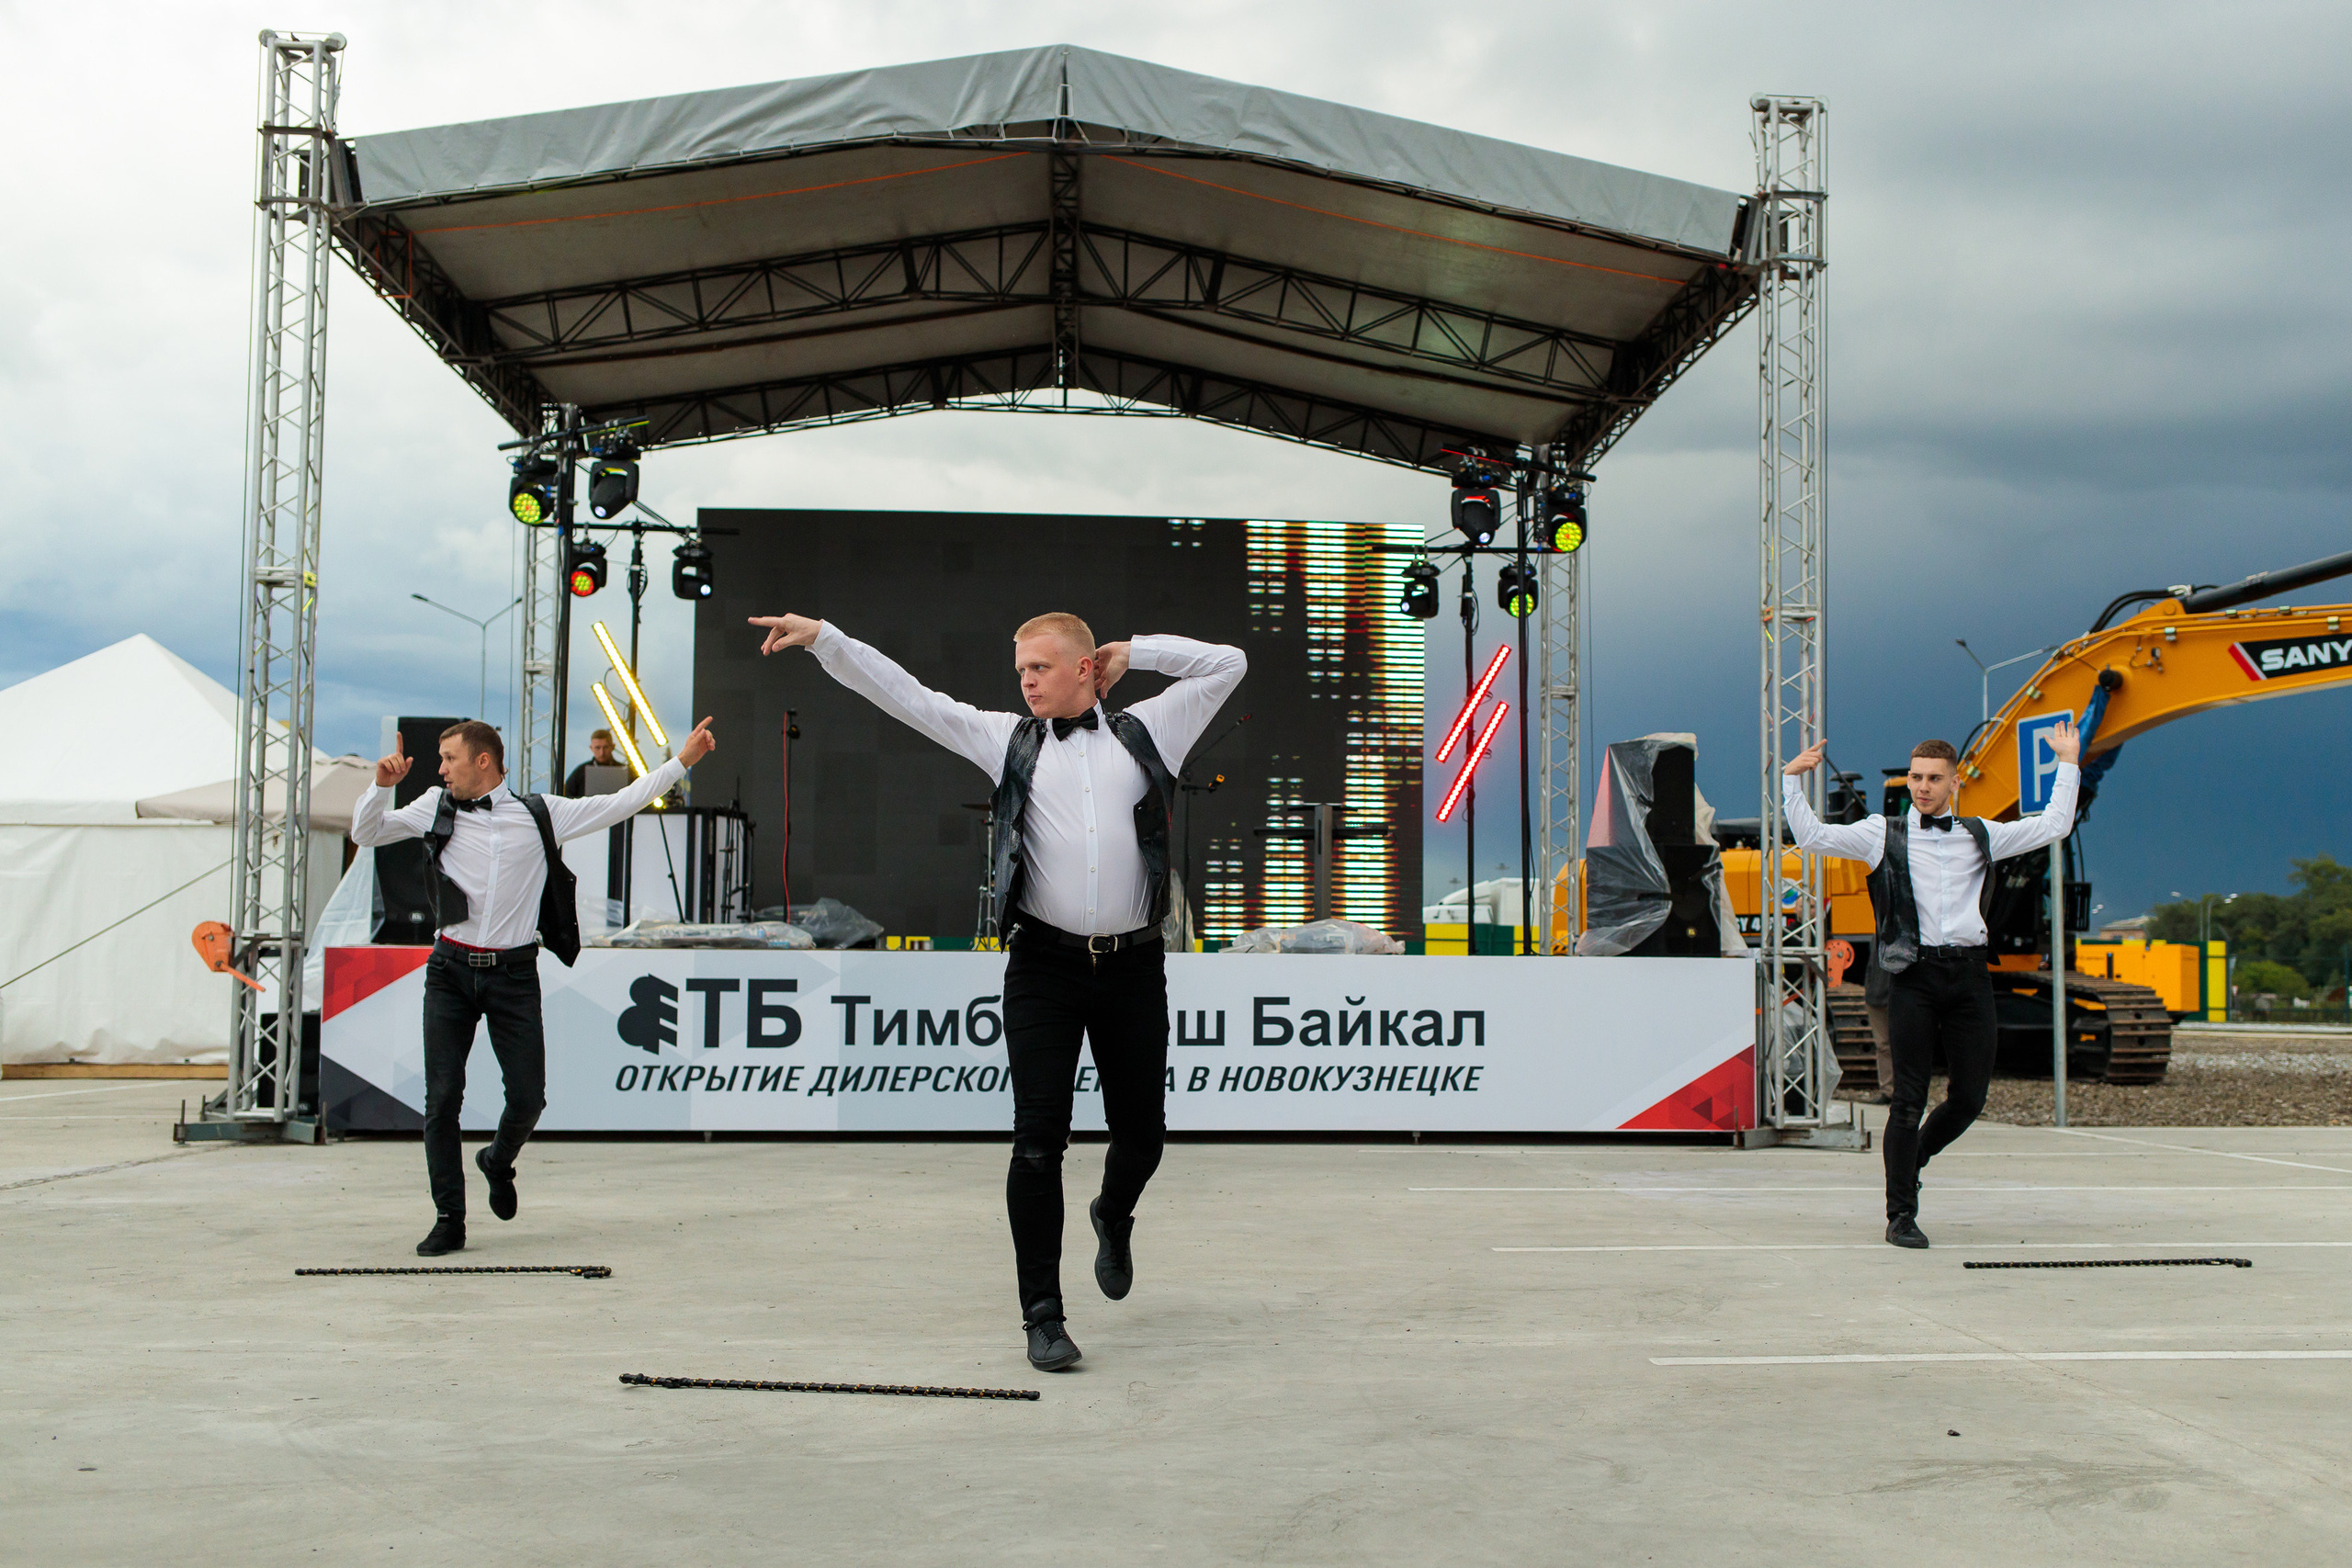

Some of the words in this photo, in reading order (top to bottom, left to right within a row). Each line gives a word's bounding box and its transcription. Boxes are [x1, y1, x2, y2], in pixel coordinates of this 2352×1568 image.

[2260, 639, 2352, 671] SANY
[2033, 726, 2061, 802] P
[685, 977, 802, 1049] ТБ
[831, 994, 1226, 1046] Тимбш
[1252, 996, 1485, 1047] Байкал
[615, 1065, 805, 1092] ОТКРЫТИЕ
[1186, 1066, 1210, 1092] В
[1218, 1065, 1485, 1097] НОВОКУЗНЕЦКЕ
